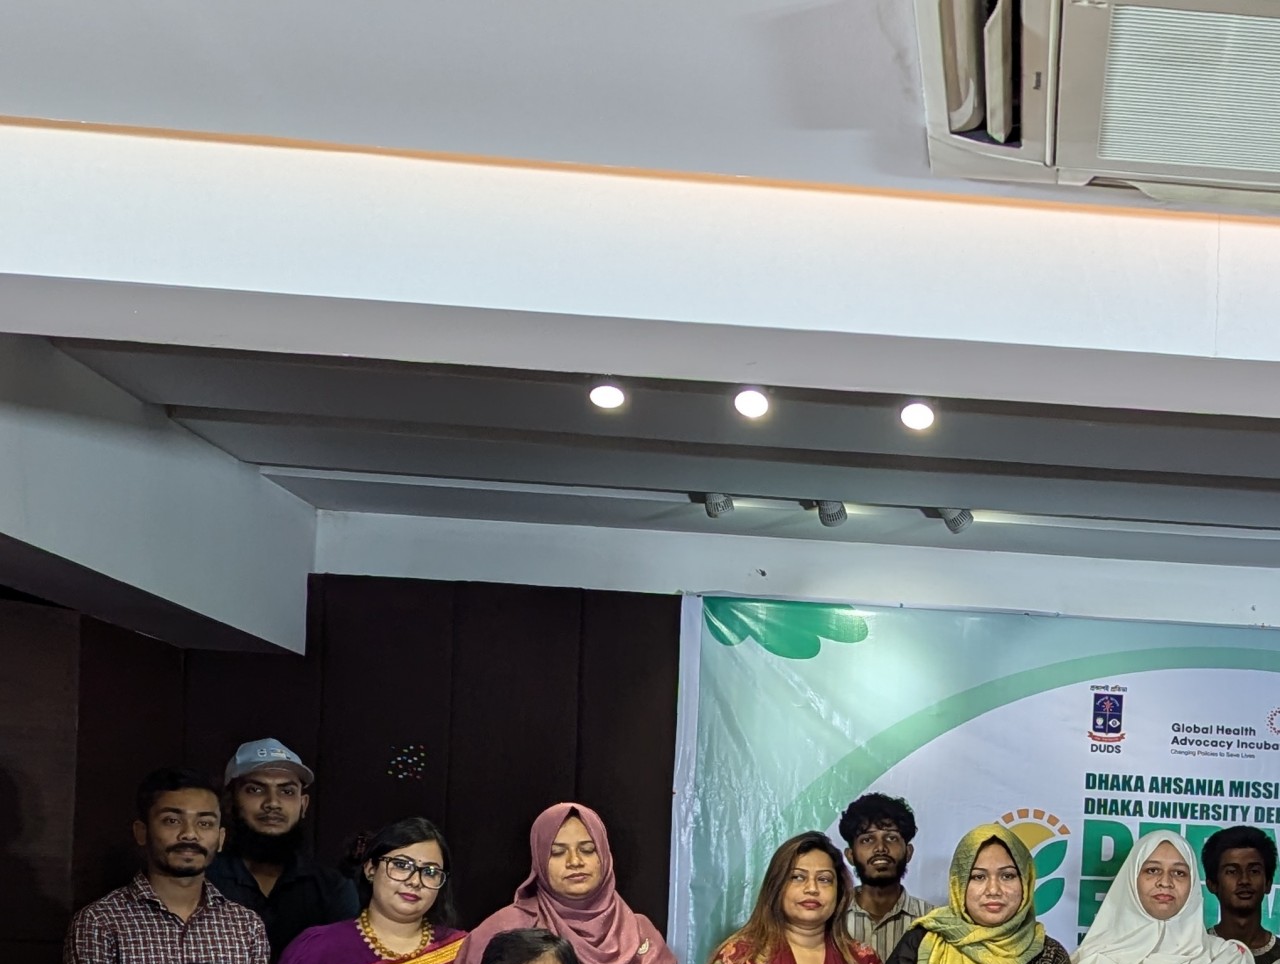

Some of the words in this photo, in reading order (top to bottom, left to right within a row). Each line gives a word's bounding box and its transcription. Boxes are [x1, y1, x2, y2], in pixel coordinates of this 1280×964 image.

[1171, 723, 1213, 734] Global
[1216, 725, 1256, 736] Health
[1091, 744, 1121, 754] DUDS
[1171, 736, 1233, 750] Advocacy
[1170, 749, 1196, 757] Changing
[1085, 773, 1145, 792] DHAKA
[1148, 776, 1224, 797] AHSANIA
[1084, 798, 1144, 817] DHAKA
[1148, 801, 1250, 821] UNIVERSITY
